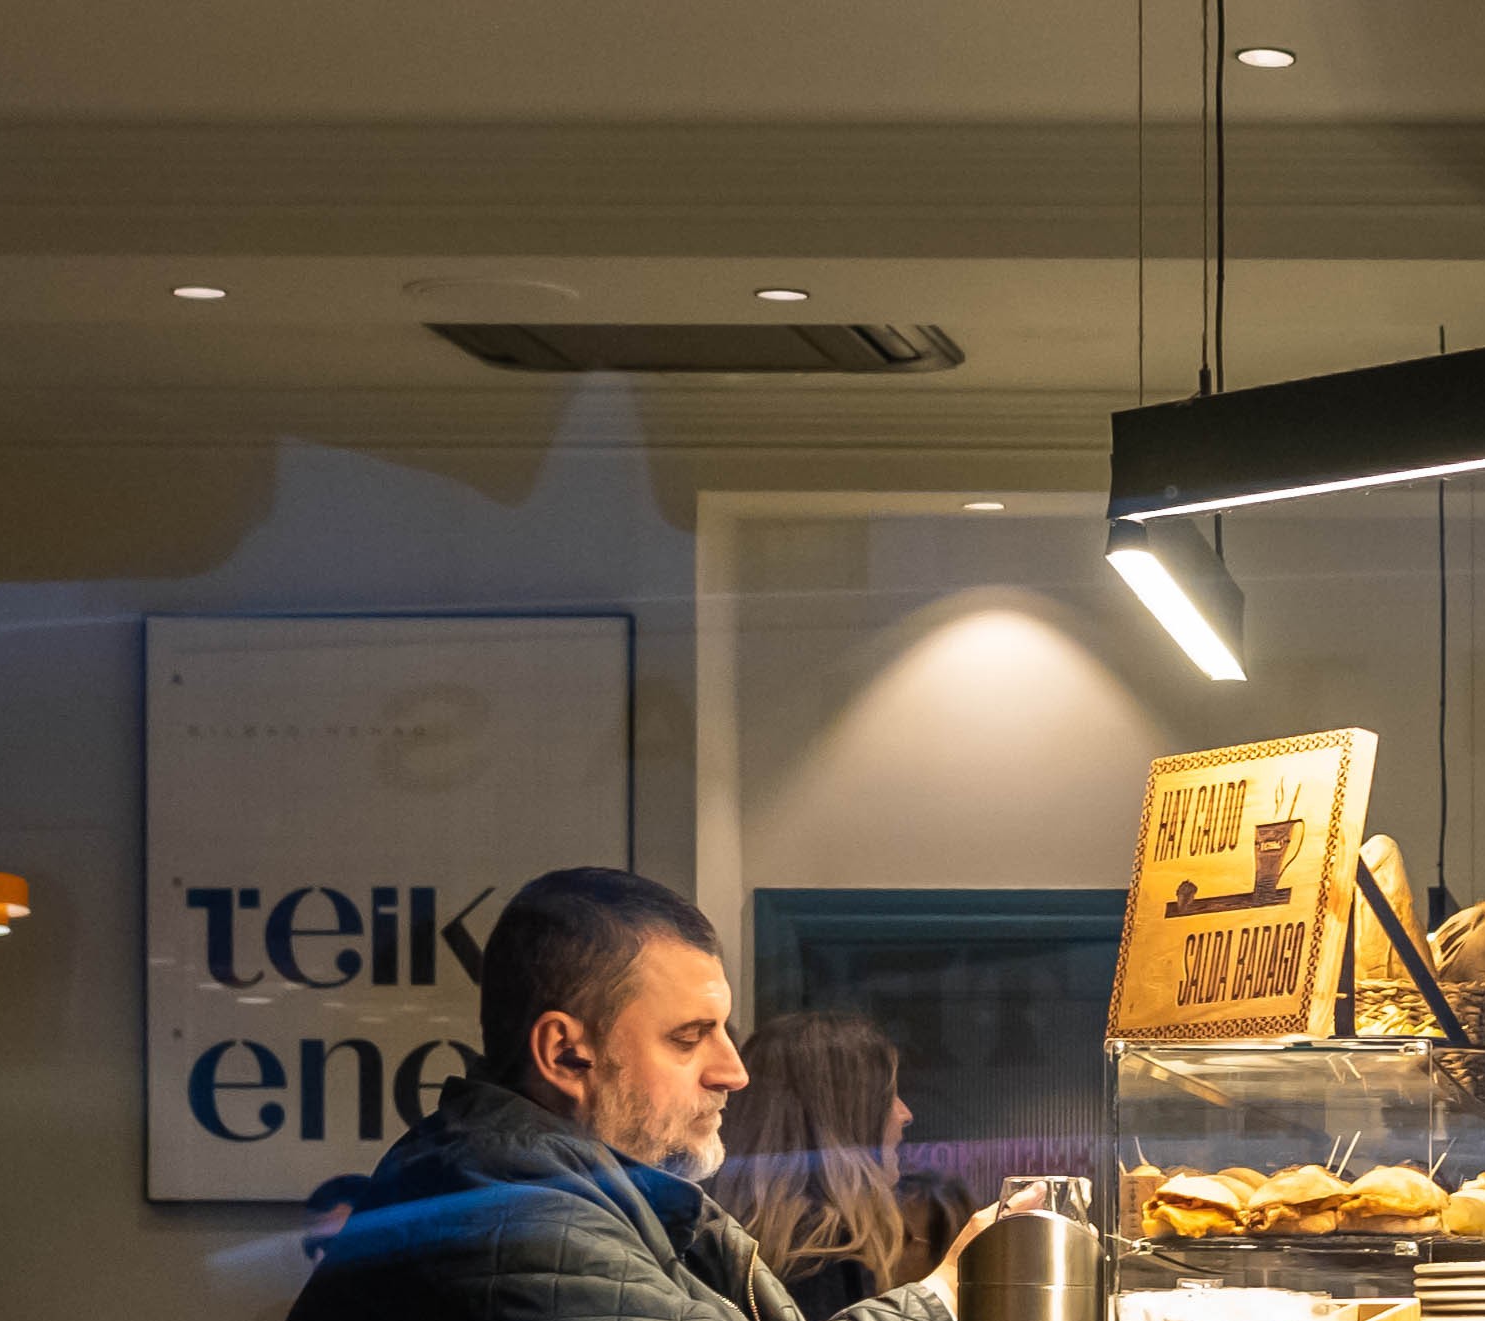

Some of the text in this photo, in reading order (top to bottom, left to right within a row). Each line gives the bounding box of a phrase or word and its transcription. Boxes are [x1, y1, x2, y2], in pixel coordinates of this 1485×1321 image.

[1153, 778, 1248, 863] HAY CALDO
[1176, 920, 1306, 1008] SALDA BADAGO
